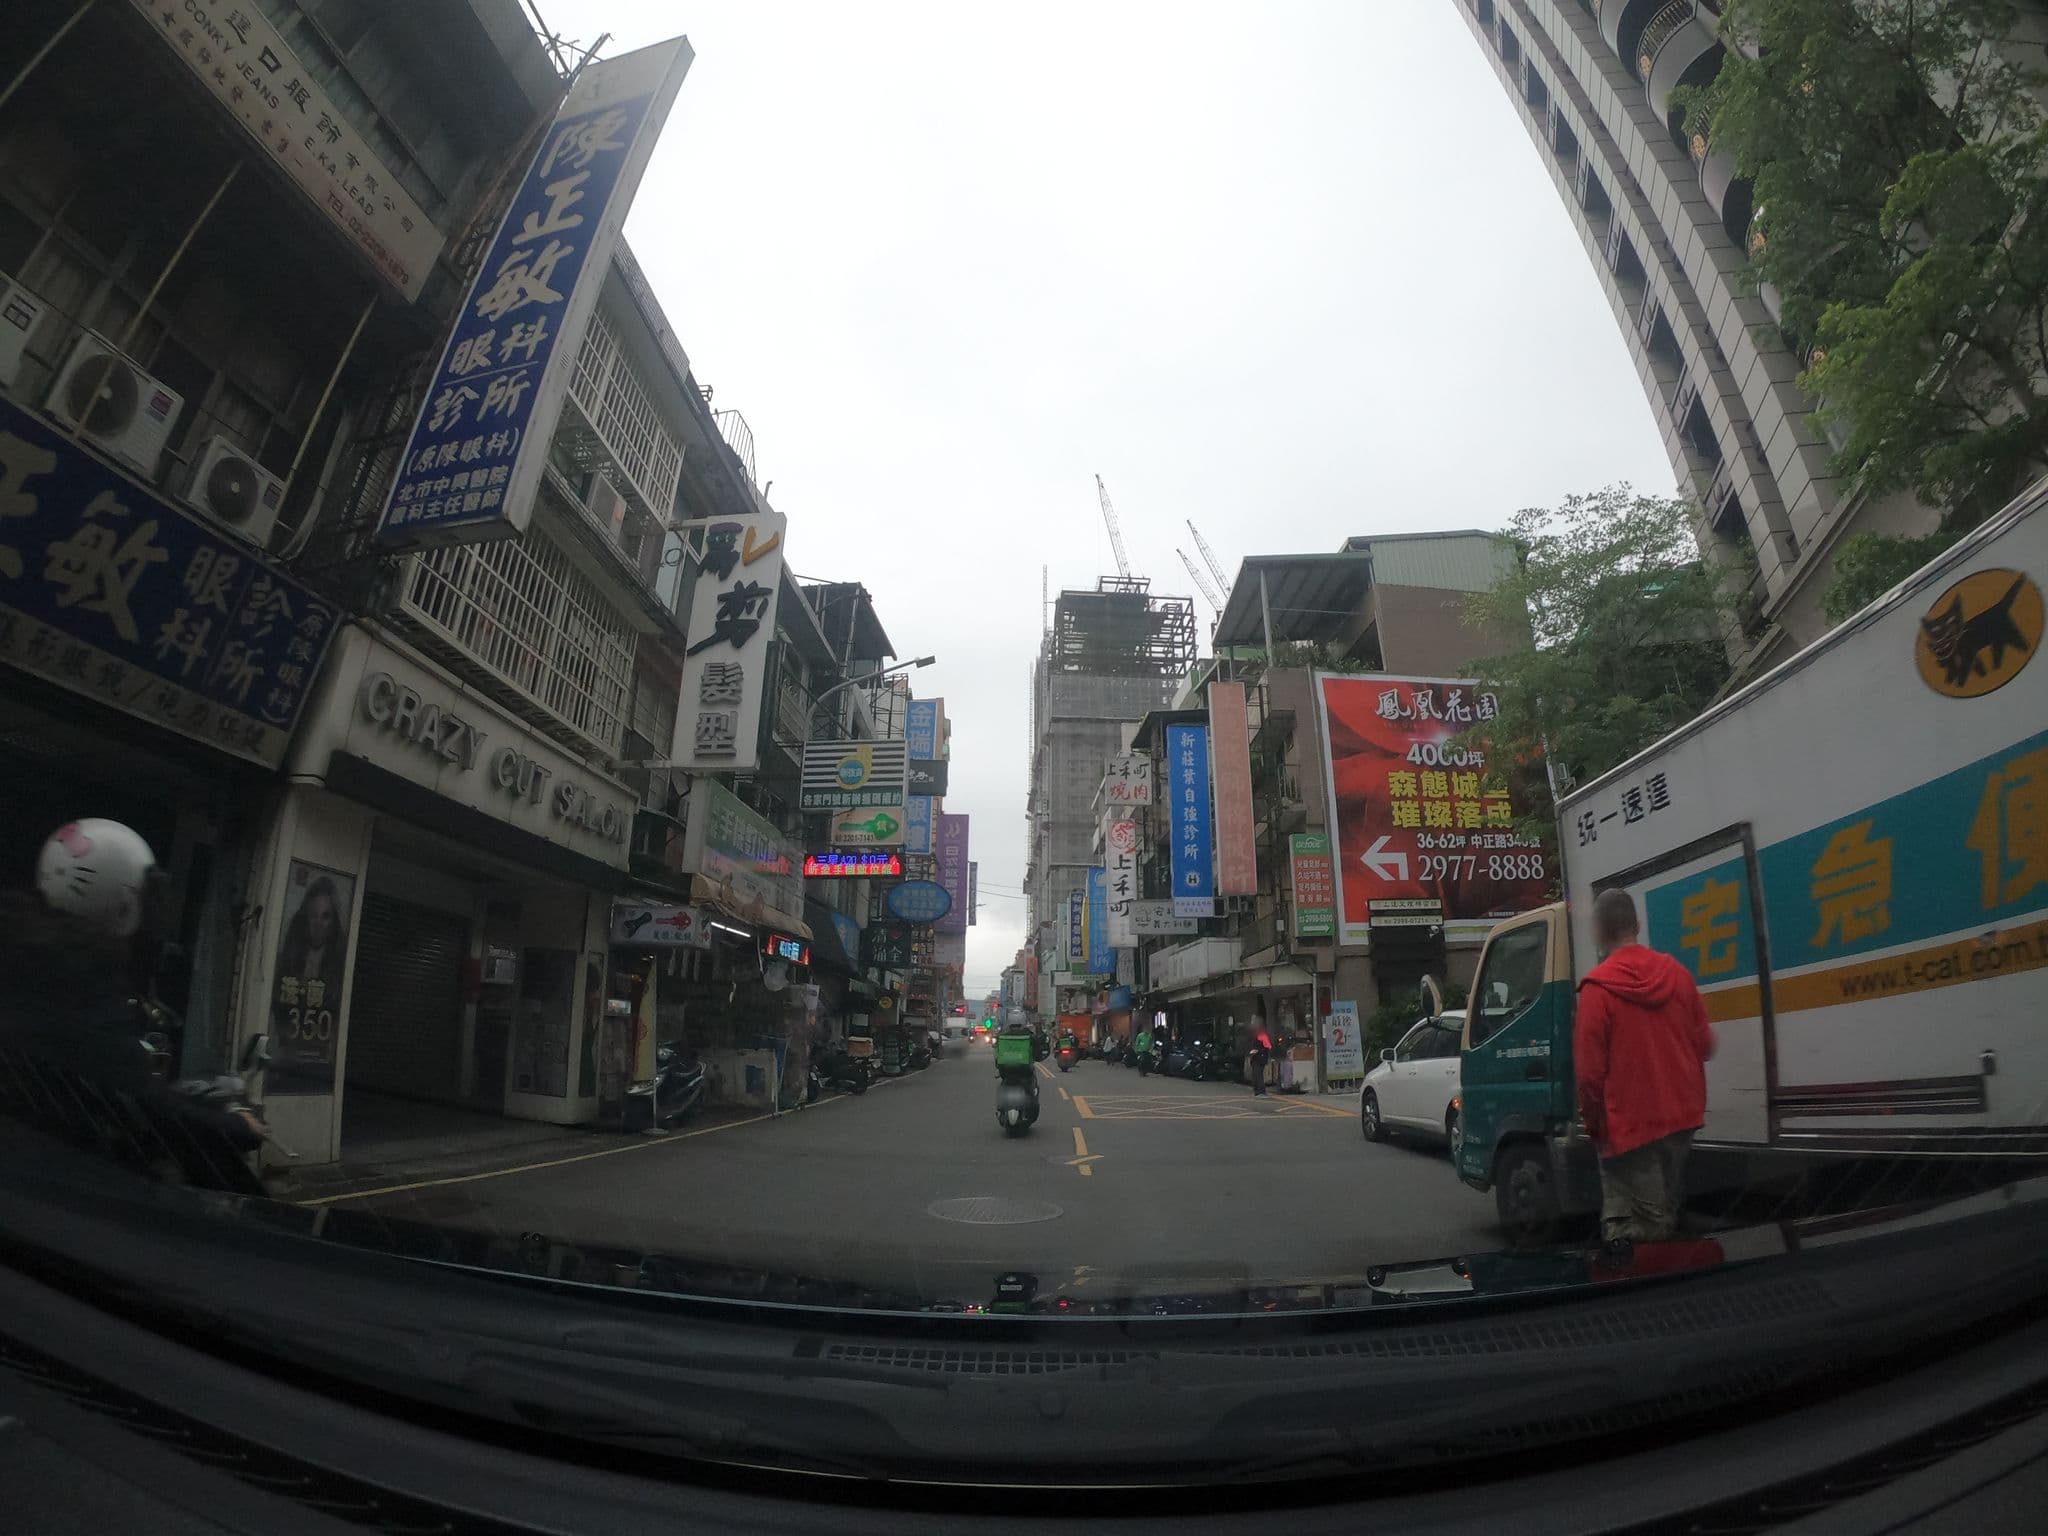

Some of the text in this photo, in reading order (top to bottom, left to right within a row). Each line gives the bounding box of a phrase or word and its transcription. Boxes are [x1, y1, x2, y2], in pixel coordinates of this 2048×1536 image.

[236, 60, 280, 110] JEANS
[467, 108, 627, 322] 陳正敏
[447, 315, 548, 375] 眼科
[427, 370, 532, 433] 診所
[693, 662, 745, 758] 髮型
[1375, 688, 1501, 722] 鳳凰花園
[363, 671, 488, 771] CRAZY
[495, 747, 553, 805] CUT
[1110, 782, 1148, 800] 燒肉
[1391, 800, 1513, 829] 璀璨落成
[1418, 855, 1545, 881] 2977-8888
[286, 1008, 332, 1041] 350
